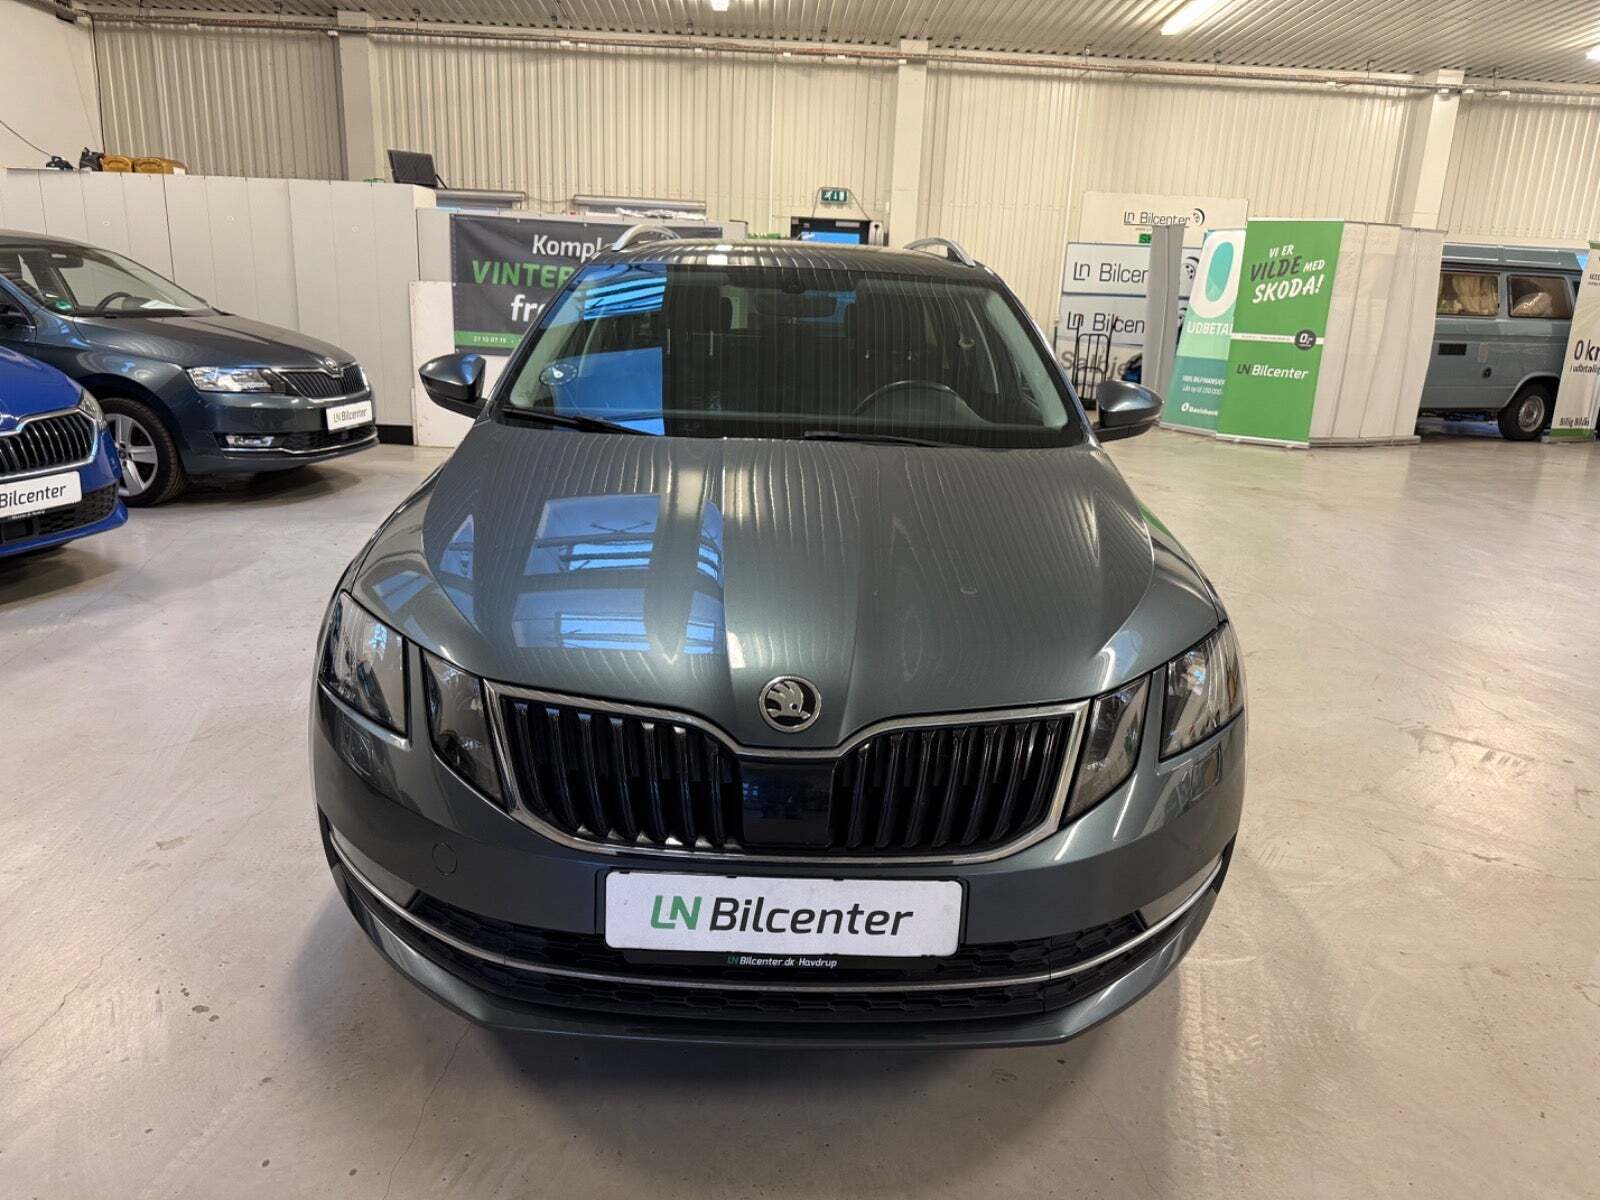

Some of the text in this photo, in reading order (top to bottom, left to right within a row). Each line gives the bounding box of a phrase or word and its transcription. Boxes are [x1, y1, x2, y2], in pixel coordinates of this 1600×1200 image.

[1140, 211, 1190, 226] Bilcenter
[1269, 245, 1294, 258] VI ER
[1250, 256, 1325, 282] VILDE MED
[1252, 274, 1325, 303] SKODA!
[1252, 364, 1309, 380] Bilcenter
[0, 485, 66, 509] Bilcenter
[709, 896, 914, 936] Bilcenter
[798, 957, 838, 969] Havdrup
